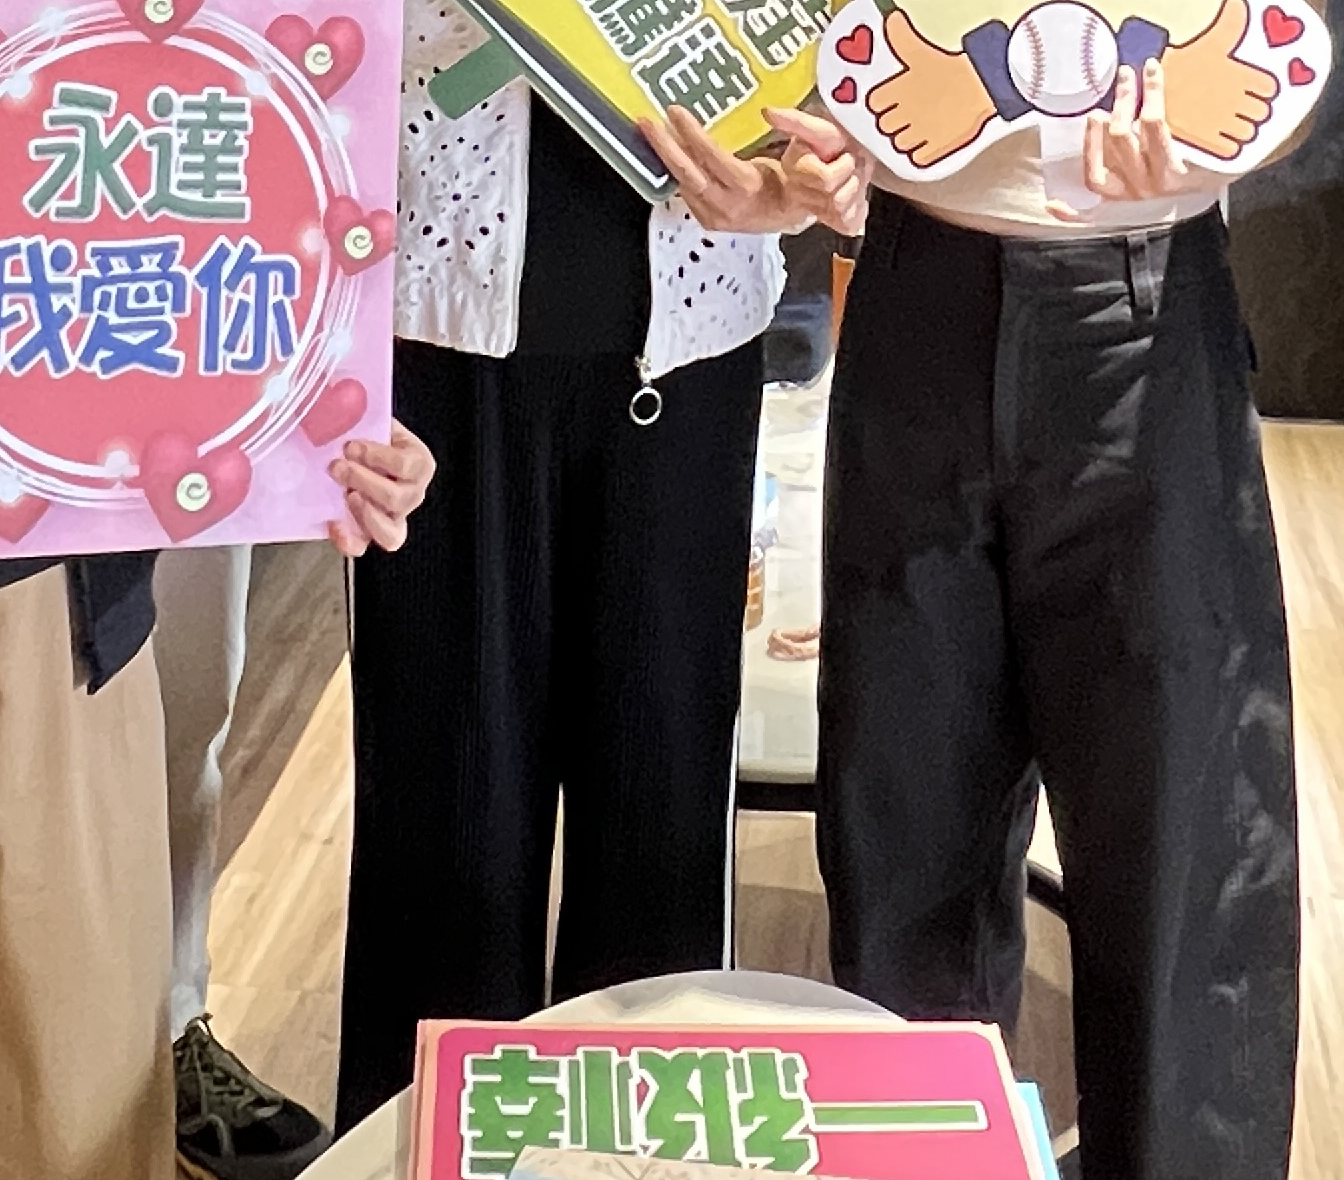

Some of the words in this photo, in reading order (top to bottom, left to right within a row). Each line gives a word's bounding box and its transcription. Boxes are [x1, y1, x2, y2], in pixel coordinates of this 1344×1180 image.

[25, 86, 248, 220] 永達
[467, 1048, 980, 1178] 一級棒
